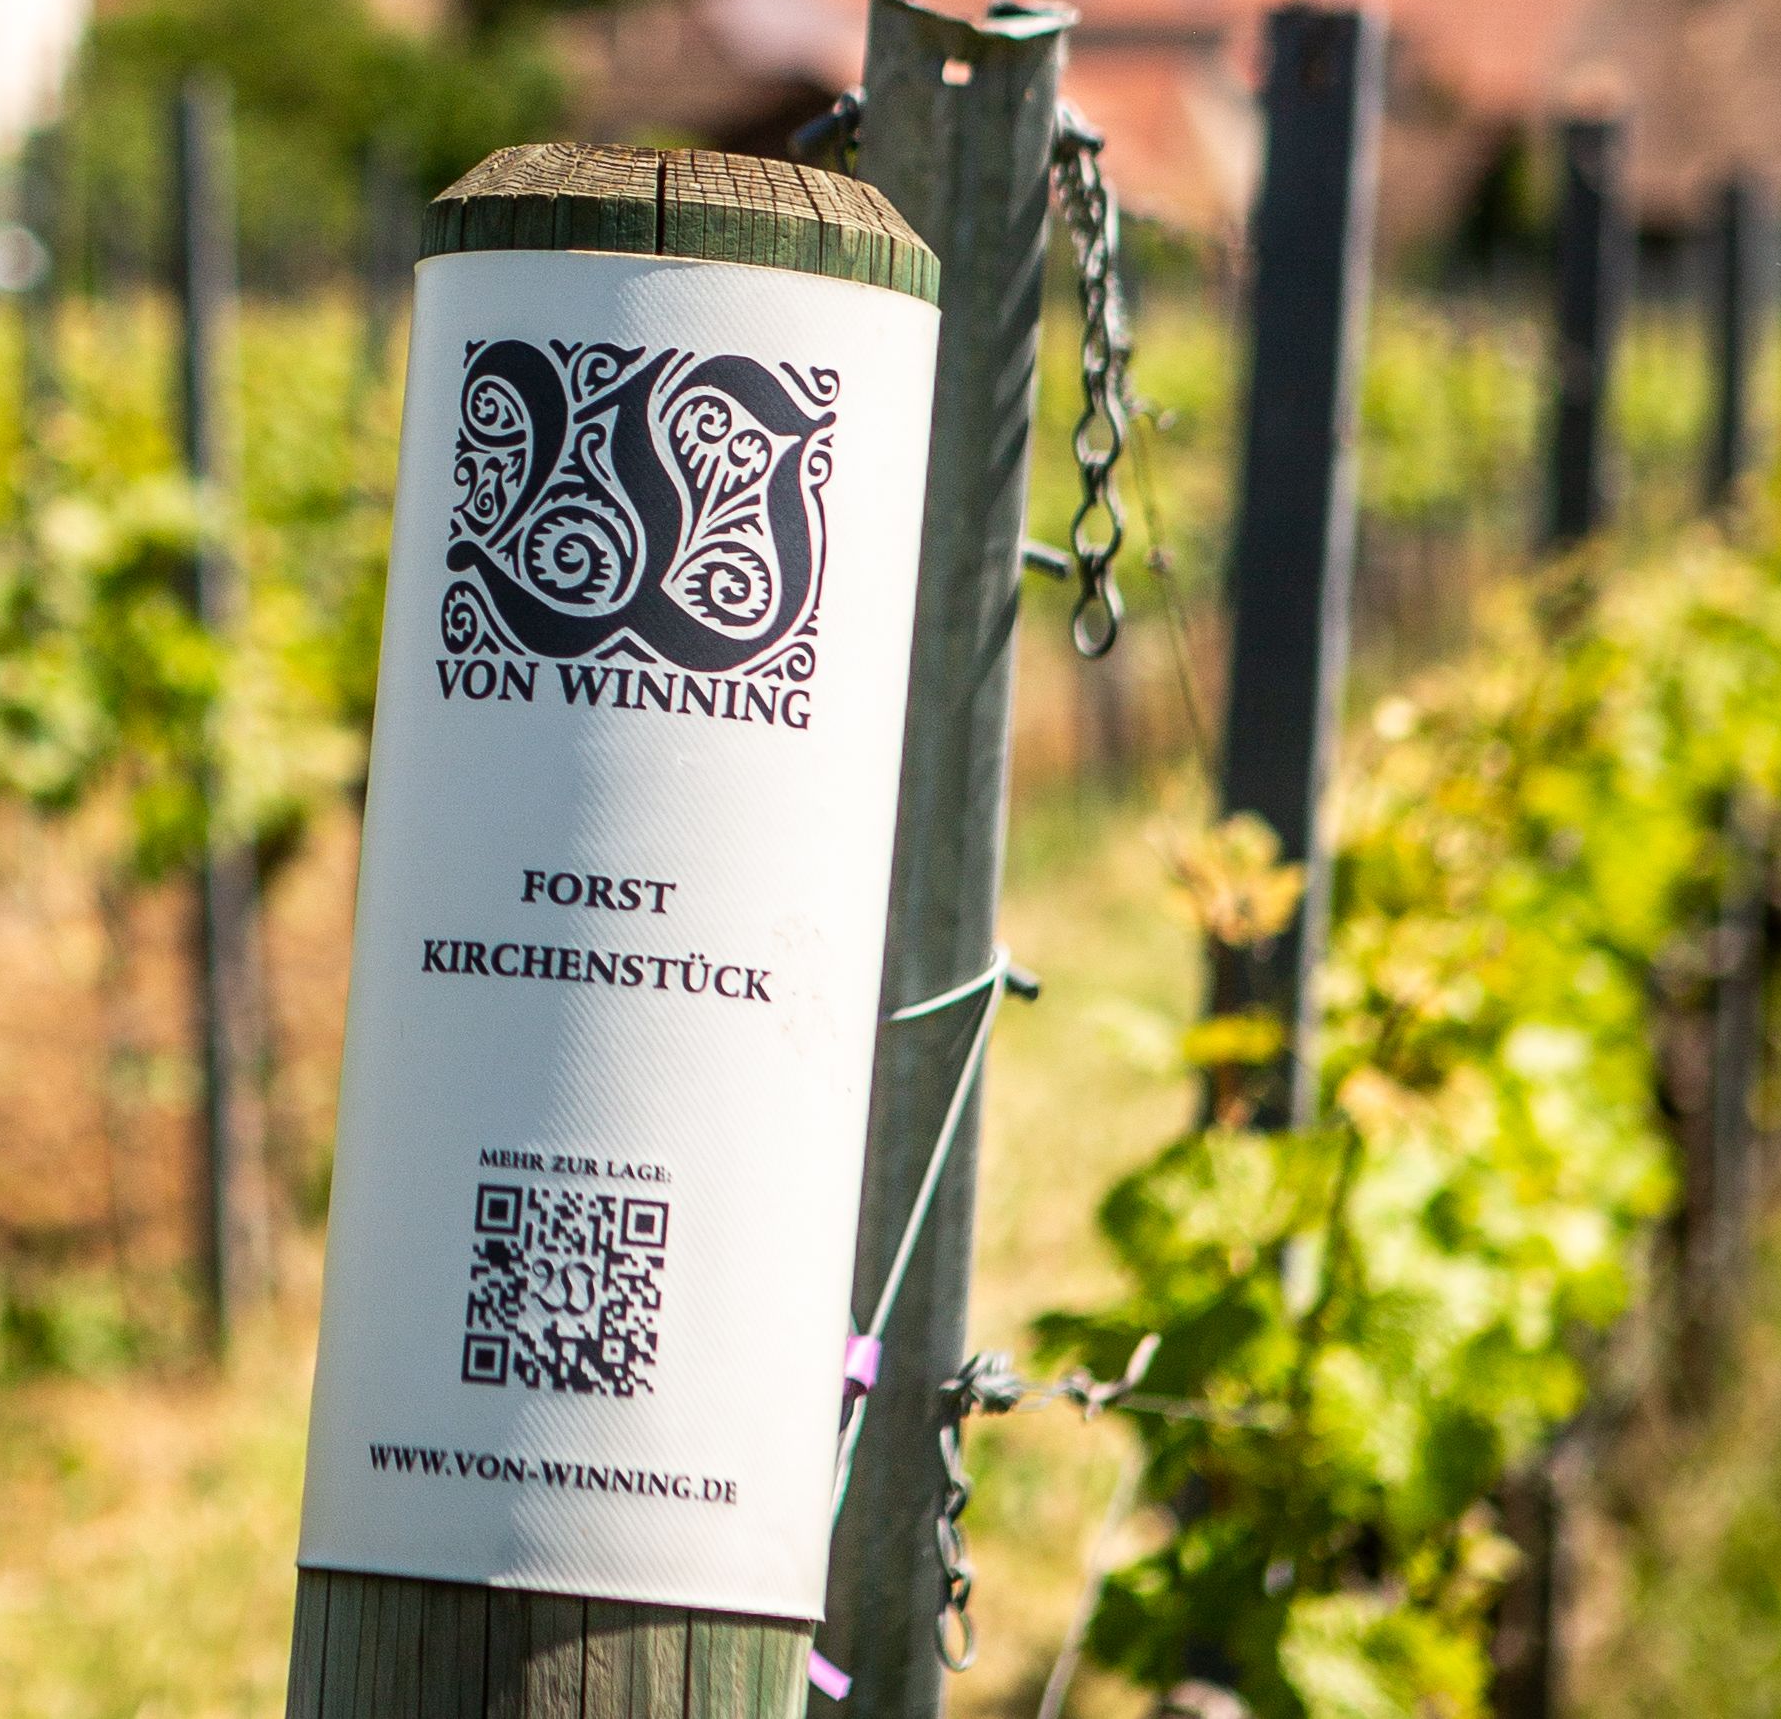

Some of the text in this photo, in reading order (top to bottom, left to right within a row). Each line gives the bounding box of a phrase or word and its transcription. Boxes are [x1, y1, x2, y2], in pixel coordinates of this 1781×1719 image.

[435, 659, 811, 729] VON WINNING
[521, 870, 677, 914] FORST
[421, 939, 772, 1002] KIRCHENSTÜCK
[479, 1147, 544, 1172] MEHR
[551, 1155, 599, 1177] ZUR
[369, 1444, 737, 1504] WWW.VON-WINNING.DE
